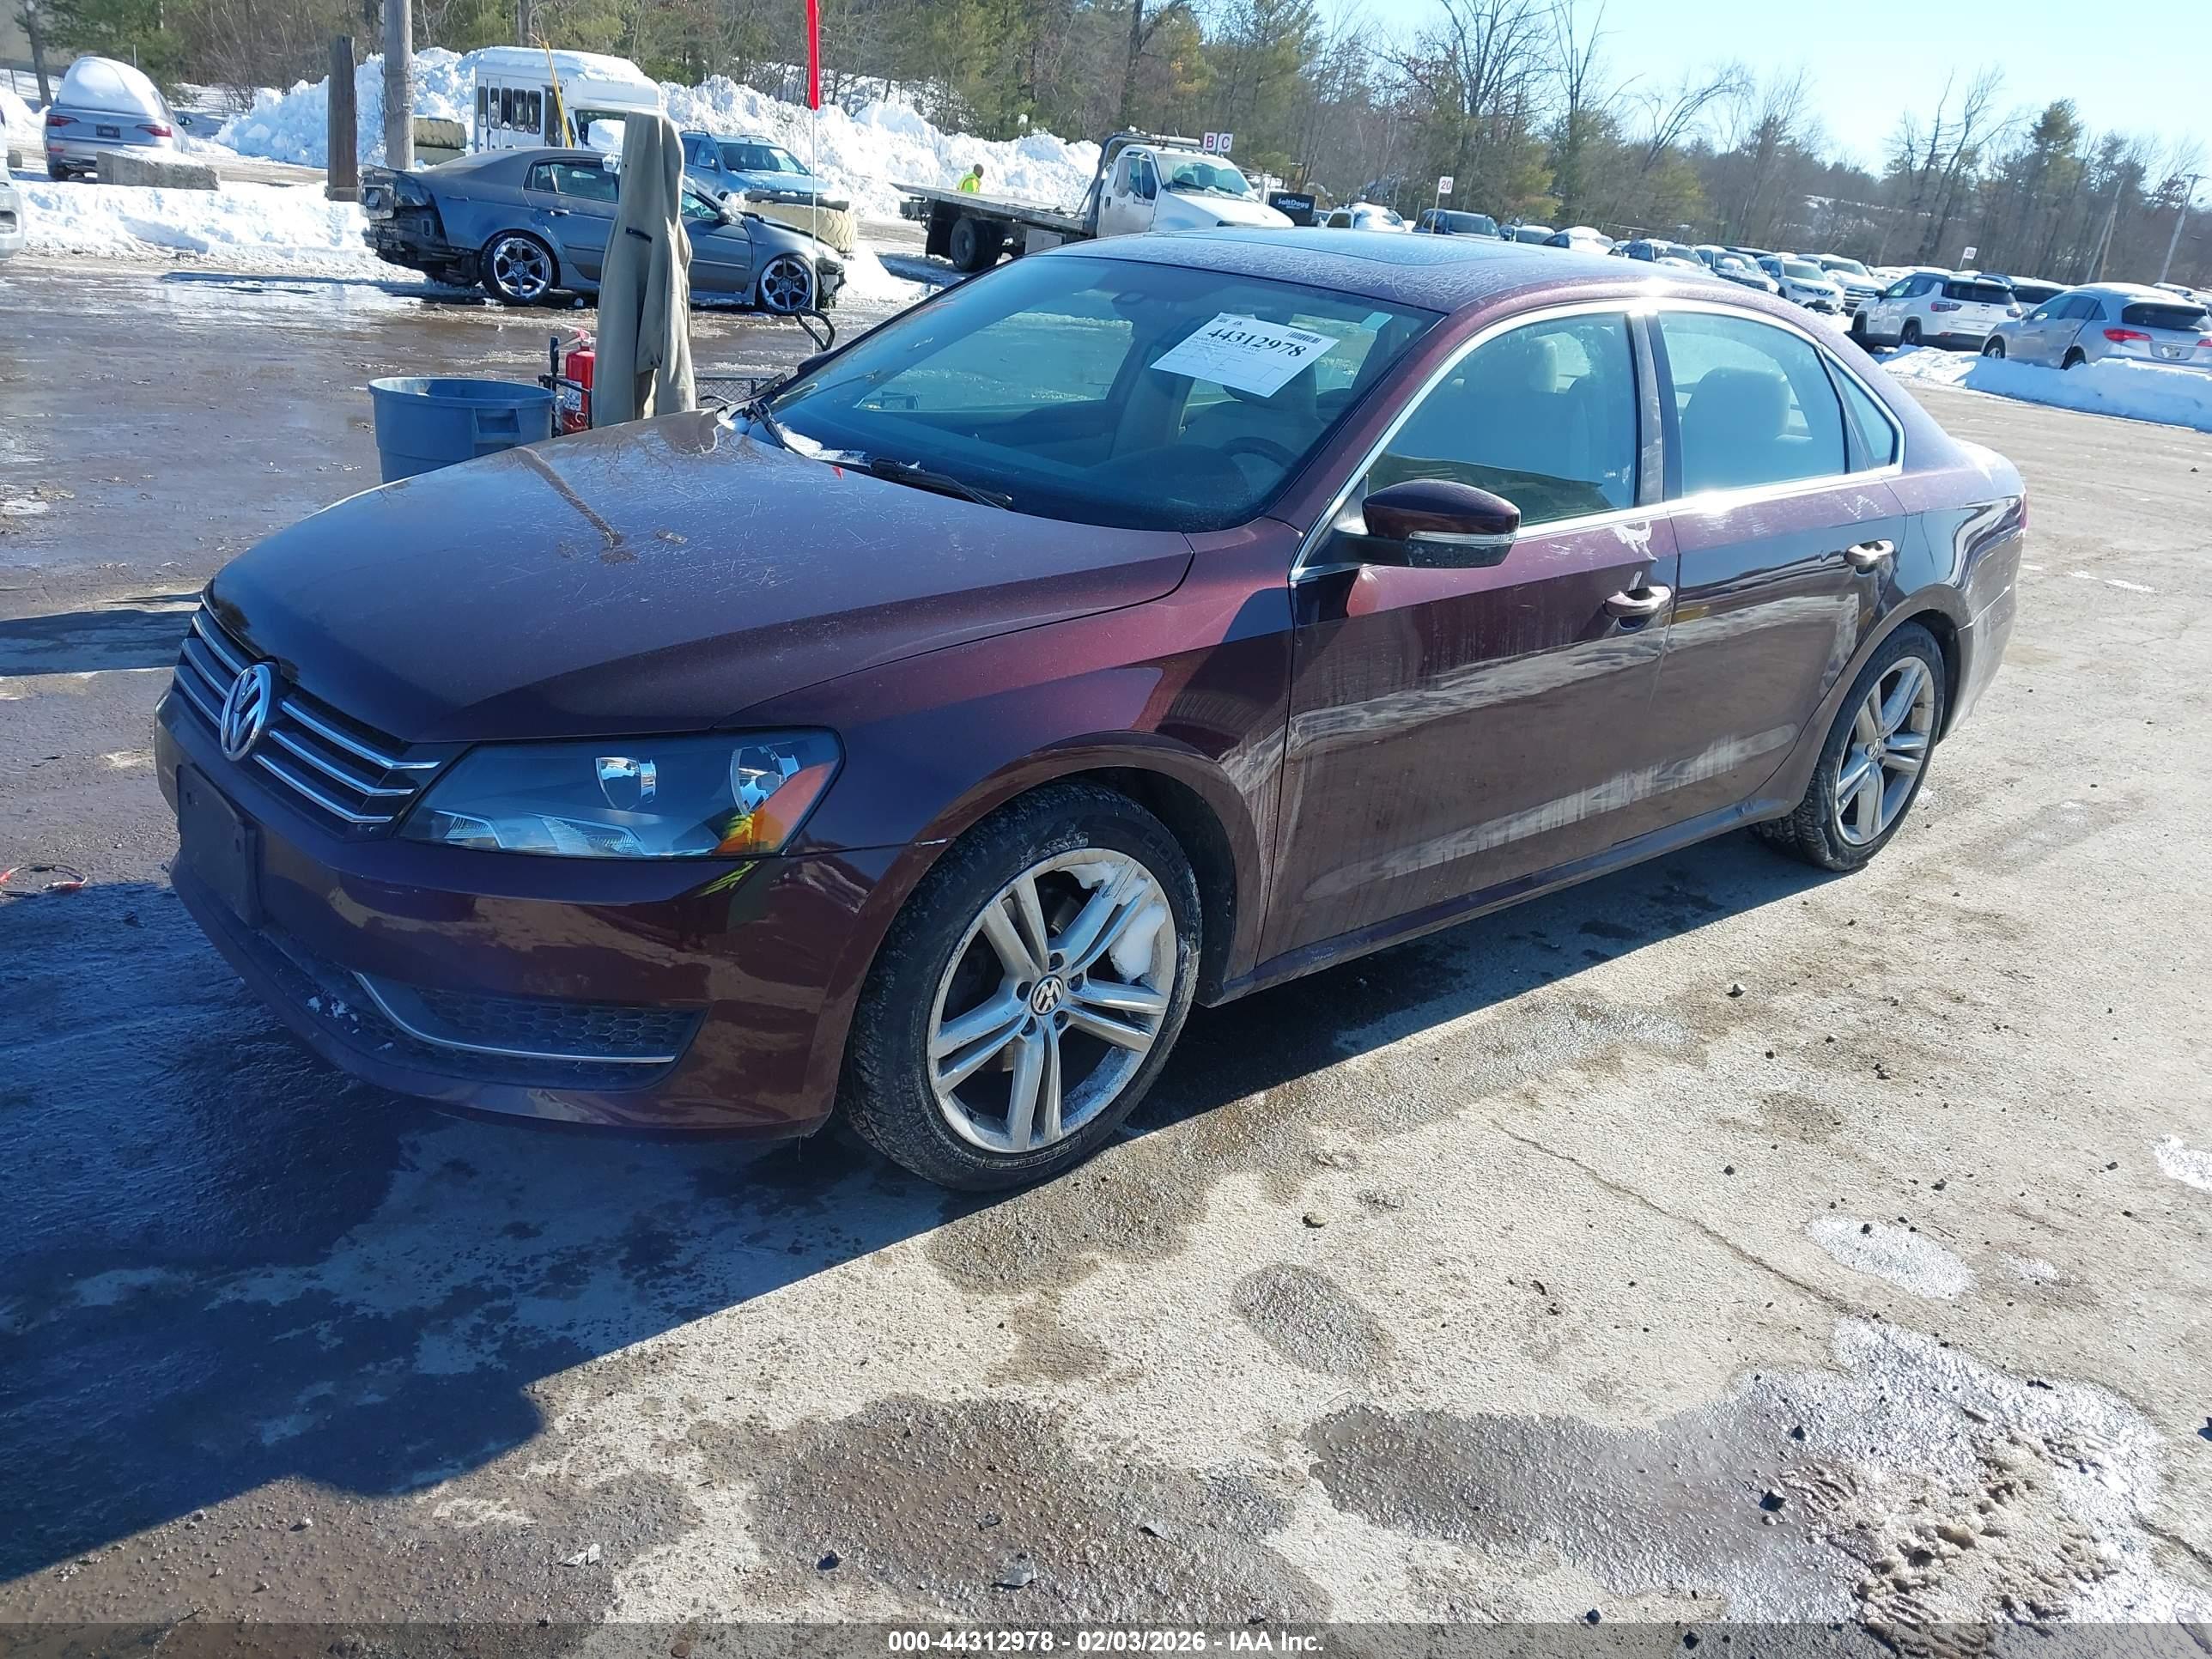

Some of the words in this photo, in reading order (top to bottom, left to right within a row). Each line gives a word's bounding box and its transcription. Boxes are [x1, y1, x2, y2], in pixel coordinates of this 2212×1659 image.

[1206, 135, 1214, 149] B
[1221, 136, 1231, 149] C
[1440, 180, 1452, 191] 20
[1207, 327, 1308, 357] 44312978
